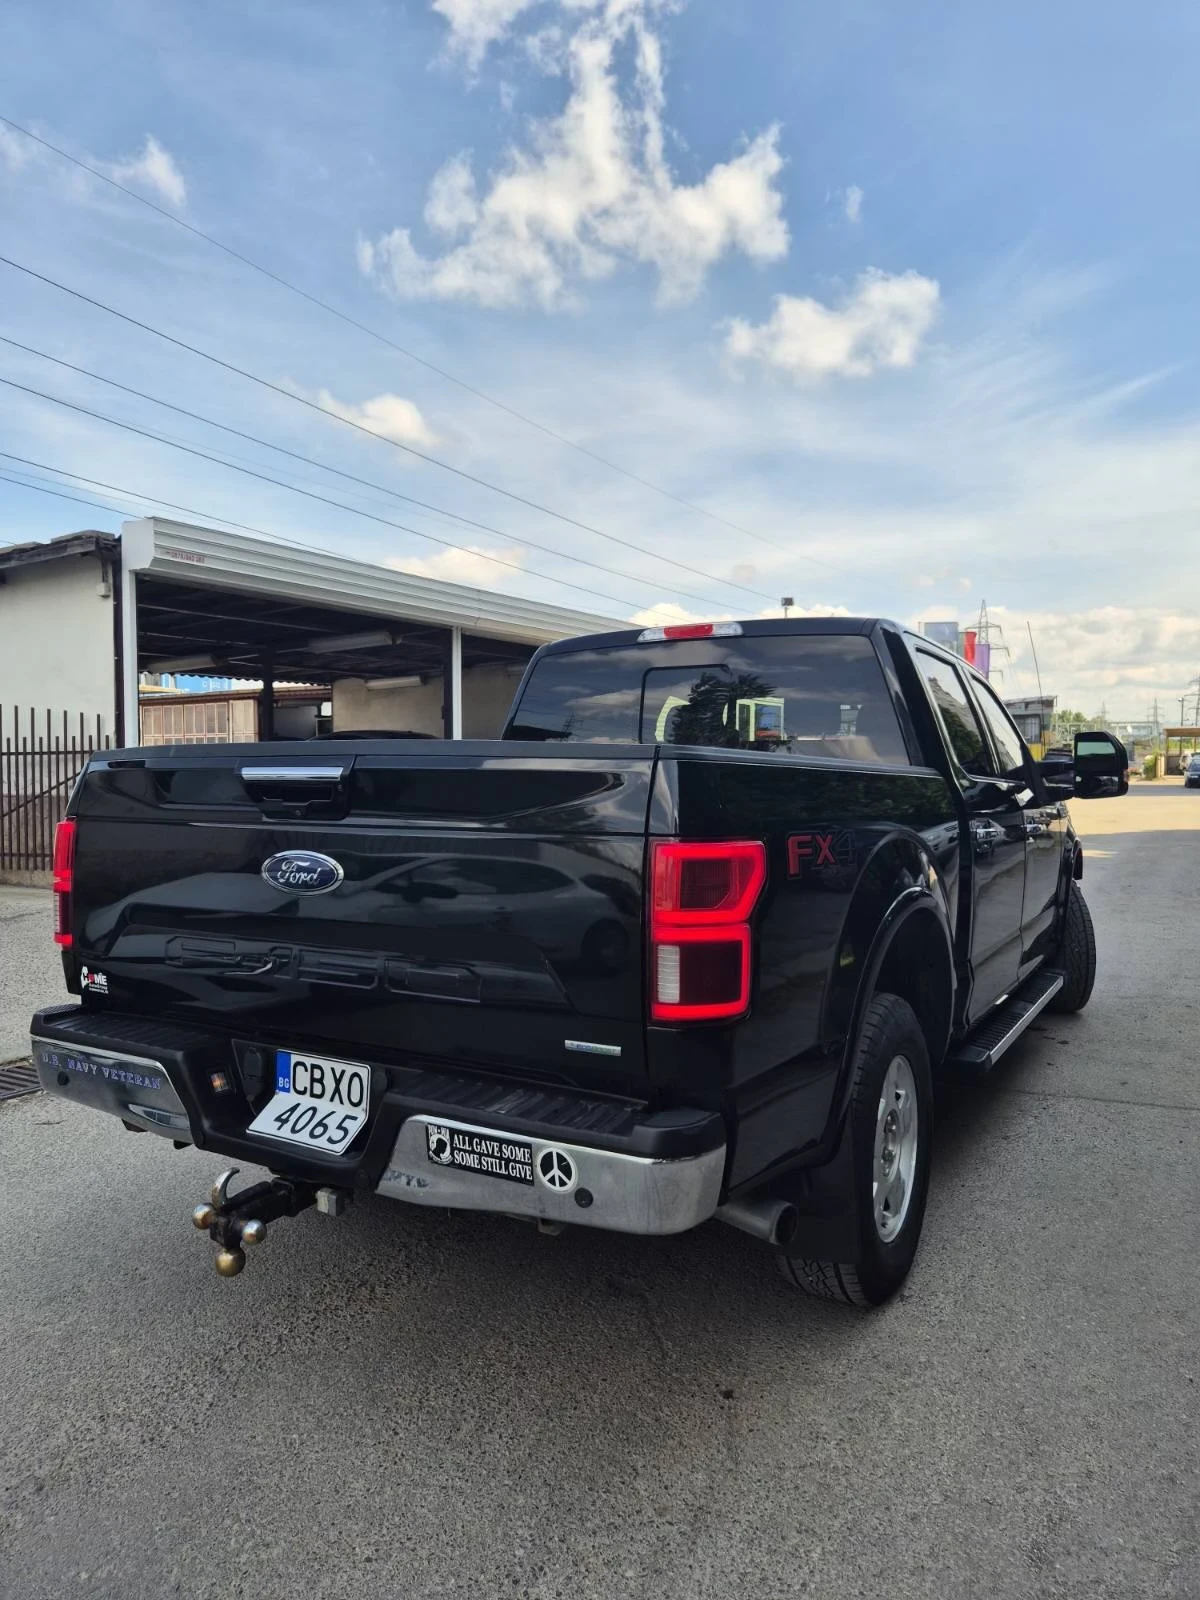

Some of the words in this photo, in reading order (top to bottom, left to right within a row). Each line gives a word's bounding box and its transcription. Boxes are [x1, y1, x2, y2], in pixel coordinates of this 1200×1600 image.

[276, 860, 330, 885] Ford
[67, 1058, 98, 1076] NAVY
[101, 1066, 161, 1089] VETERAN
[278, 1076, 290, 1089] BG
[273, 1102, 359, 1145] 4065
[453, 1133, 472, 1151] ALL
[473, 1137, 501, 1157] GAVE
[502, 1143, 532, 1163] SOME
[454, 1150, 480, 1169] SOME
[481, 1156, 508, 1175] STILL
[509, 1162, 533, 1180] GIVE
